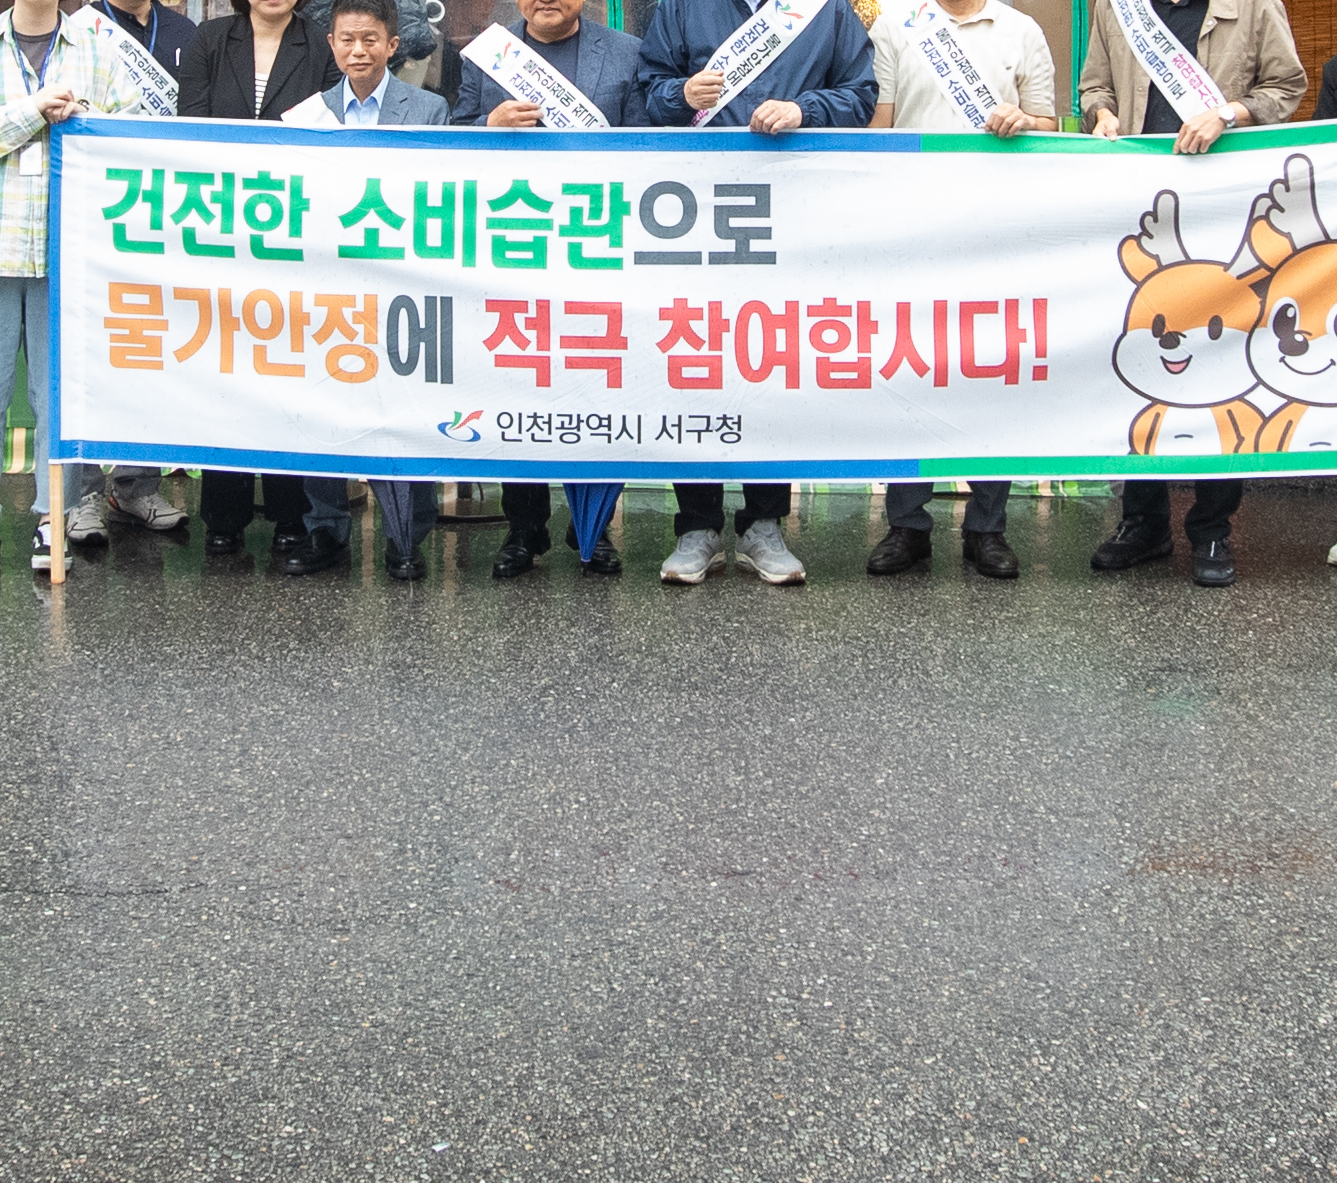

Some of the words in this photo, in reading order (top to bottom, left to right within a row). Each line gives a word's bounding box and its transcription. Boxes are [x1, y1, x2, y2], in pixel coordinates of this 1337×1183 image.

[726, 33, 782, 88] 물가안정에
[730, 18, 771, 57] 건전한
[919, 37, 953, 79] 건전한
[935, 26, 982, 86] 물가안정에
[101, 167, 311, 262] 건전한
[338, 178, 778, 270] 소비습관으로
[103, 281, 454, 385] 물가안정에
[481, 297, 629, 390] 적극
[655, 296, 1050, 391] 참여합시다!
[496, 411, 643, 445] 인천광역시
[655, 412, 743, 445] 서구청
